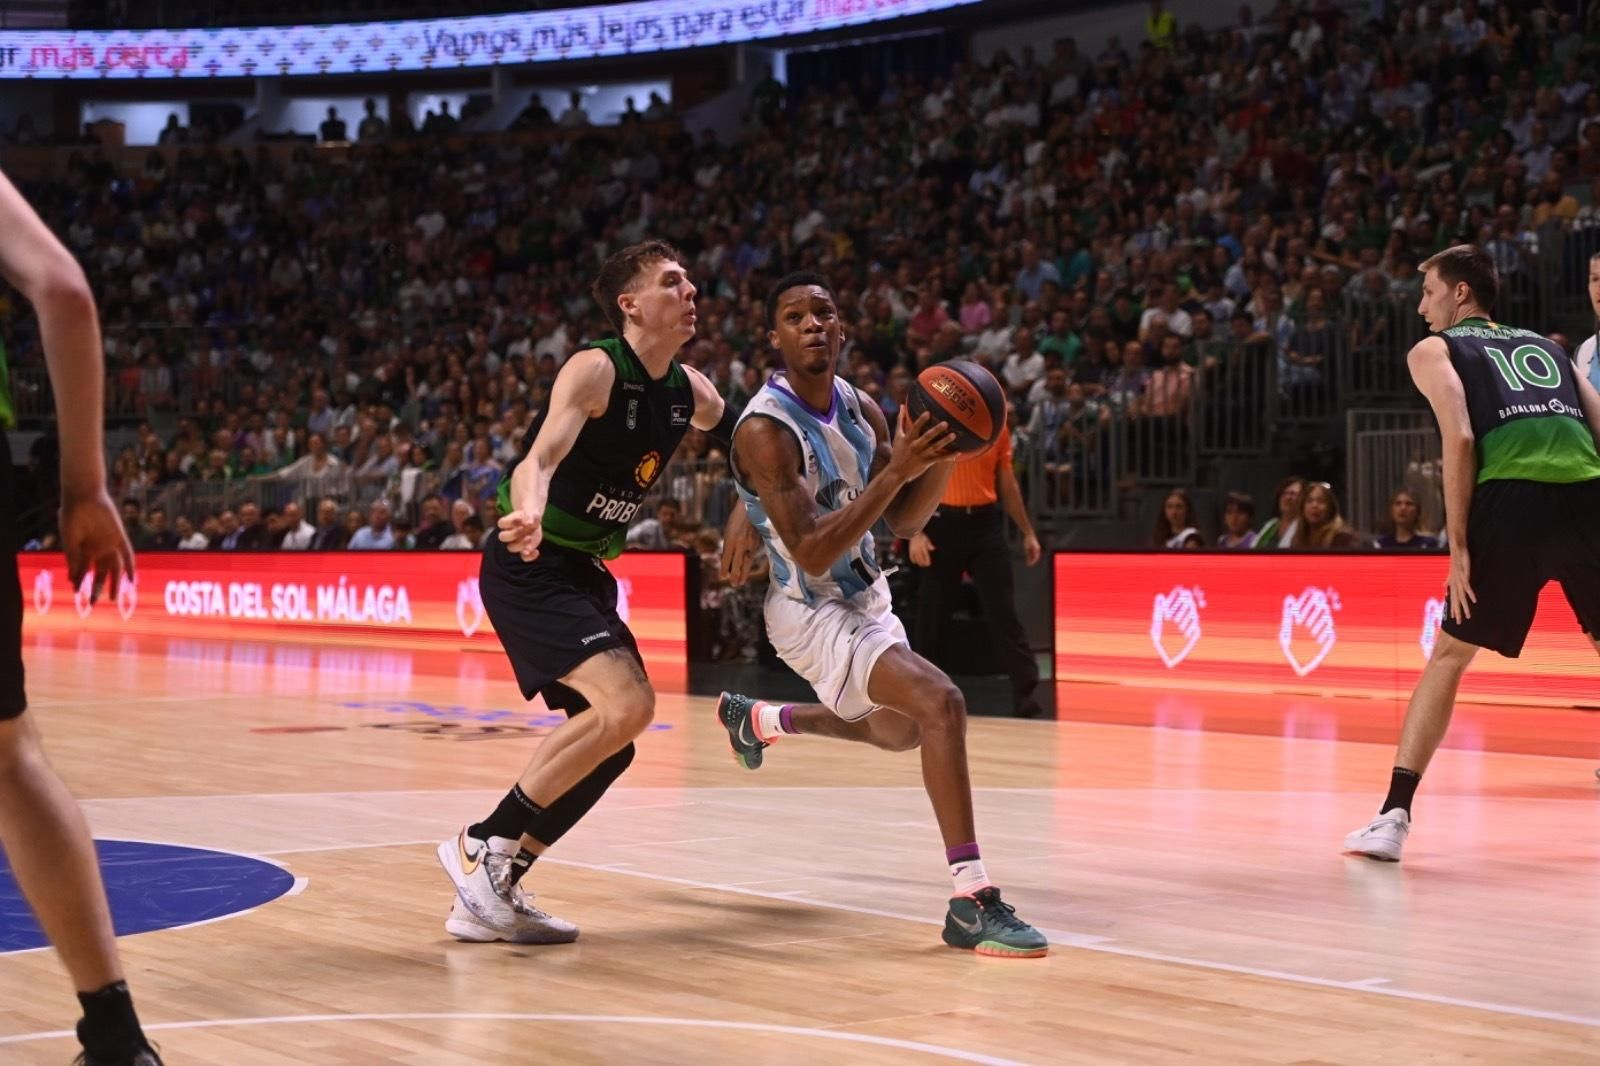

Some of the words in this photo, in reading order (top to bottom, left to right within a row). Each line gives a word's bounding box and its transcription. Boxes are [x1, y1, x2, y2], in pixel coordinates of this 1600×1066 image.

[423, 28, 520, 57] Vamos
[598, 12, 663, 52] lejos
[673, 9, 732, 43] para
[741, 0, 804, 28] estar
[105, 46, 188, 69] cerca
[1484, 344, 1562, 391] 10
[1499, 404, 1548, 419] BADALONA
[164, 580, 225, 617] COSTA
[228, 582, 268, 619] DEL
[271, 583, 313, 620] SOL
[316, 575, 412, 624] MÁLAGA
